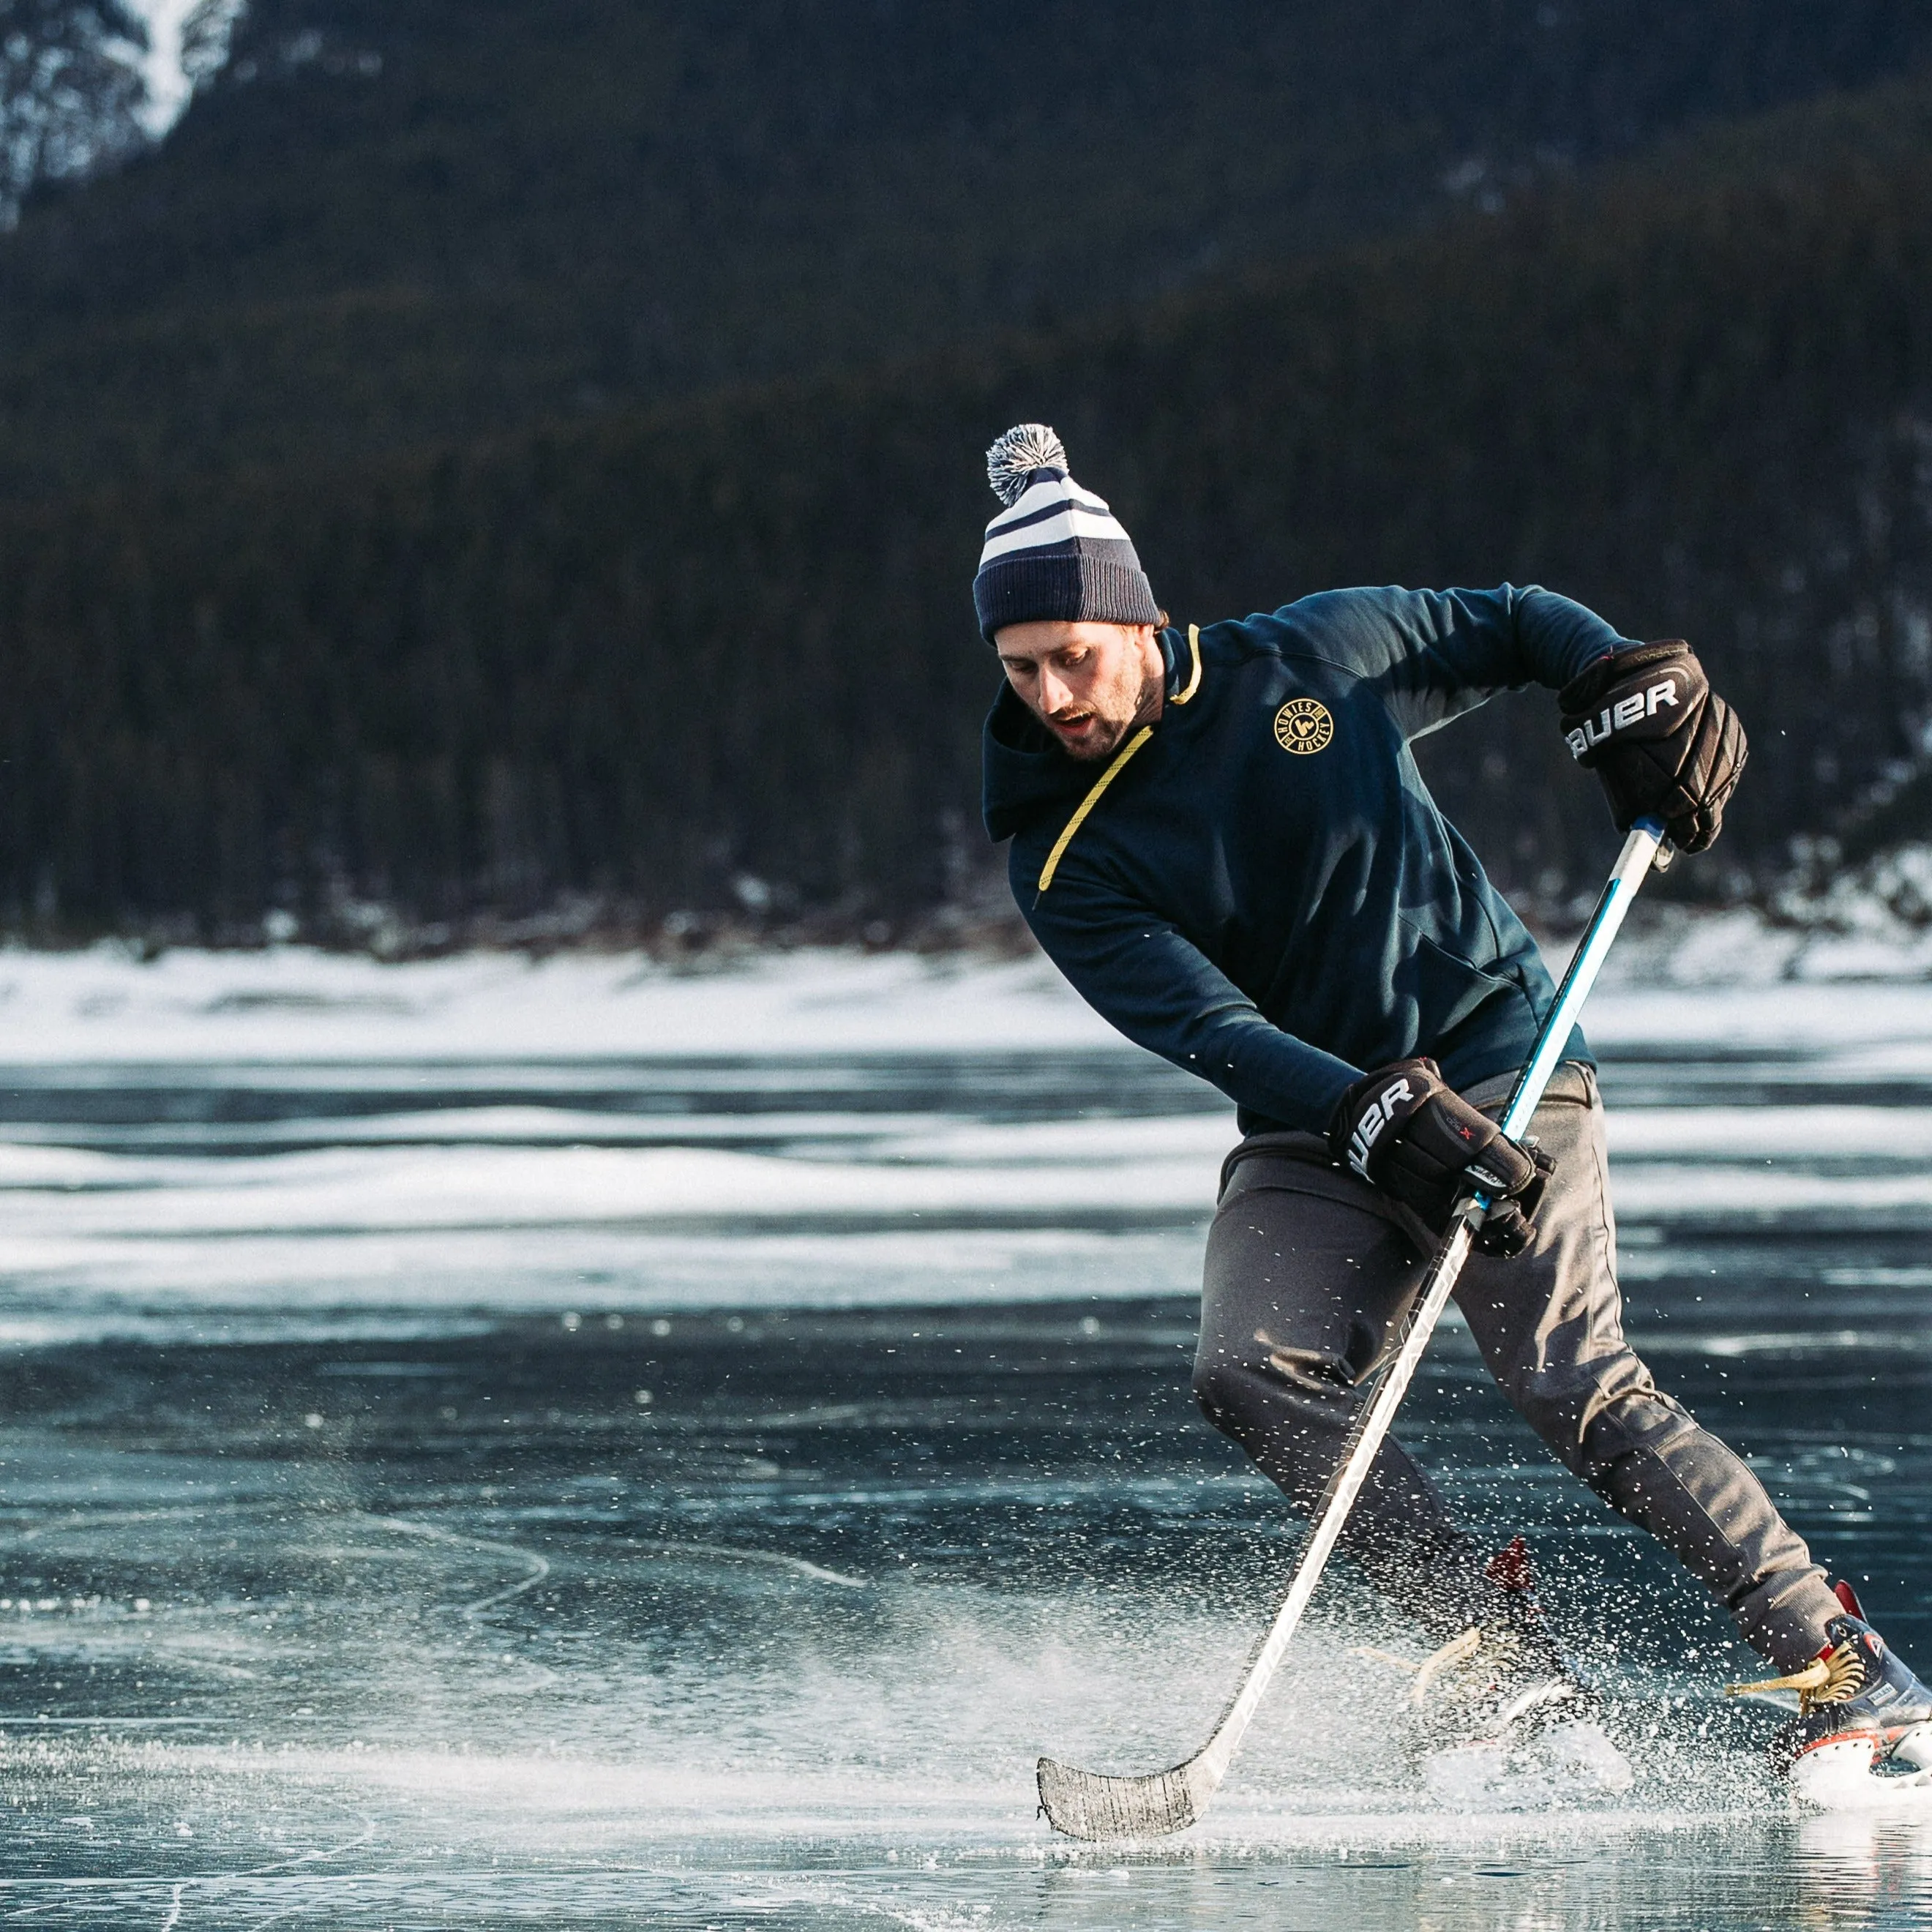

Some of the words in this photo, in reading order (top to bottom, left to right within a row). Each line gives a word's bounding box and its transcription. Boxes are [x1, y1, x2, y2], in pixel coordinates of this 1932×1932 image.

[1278, 702, 1311, 733] HOWIES
[1298, 723, 1330, 751] HOCKEY
[1565, 678, 1680, 761] AUER
[1347, 1078, 1414, 1184] UER
